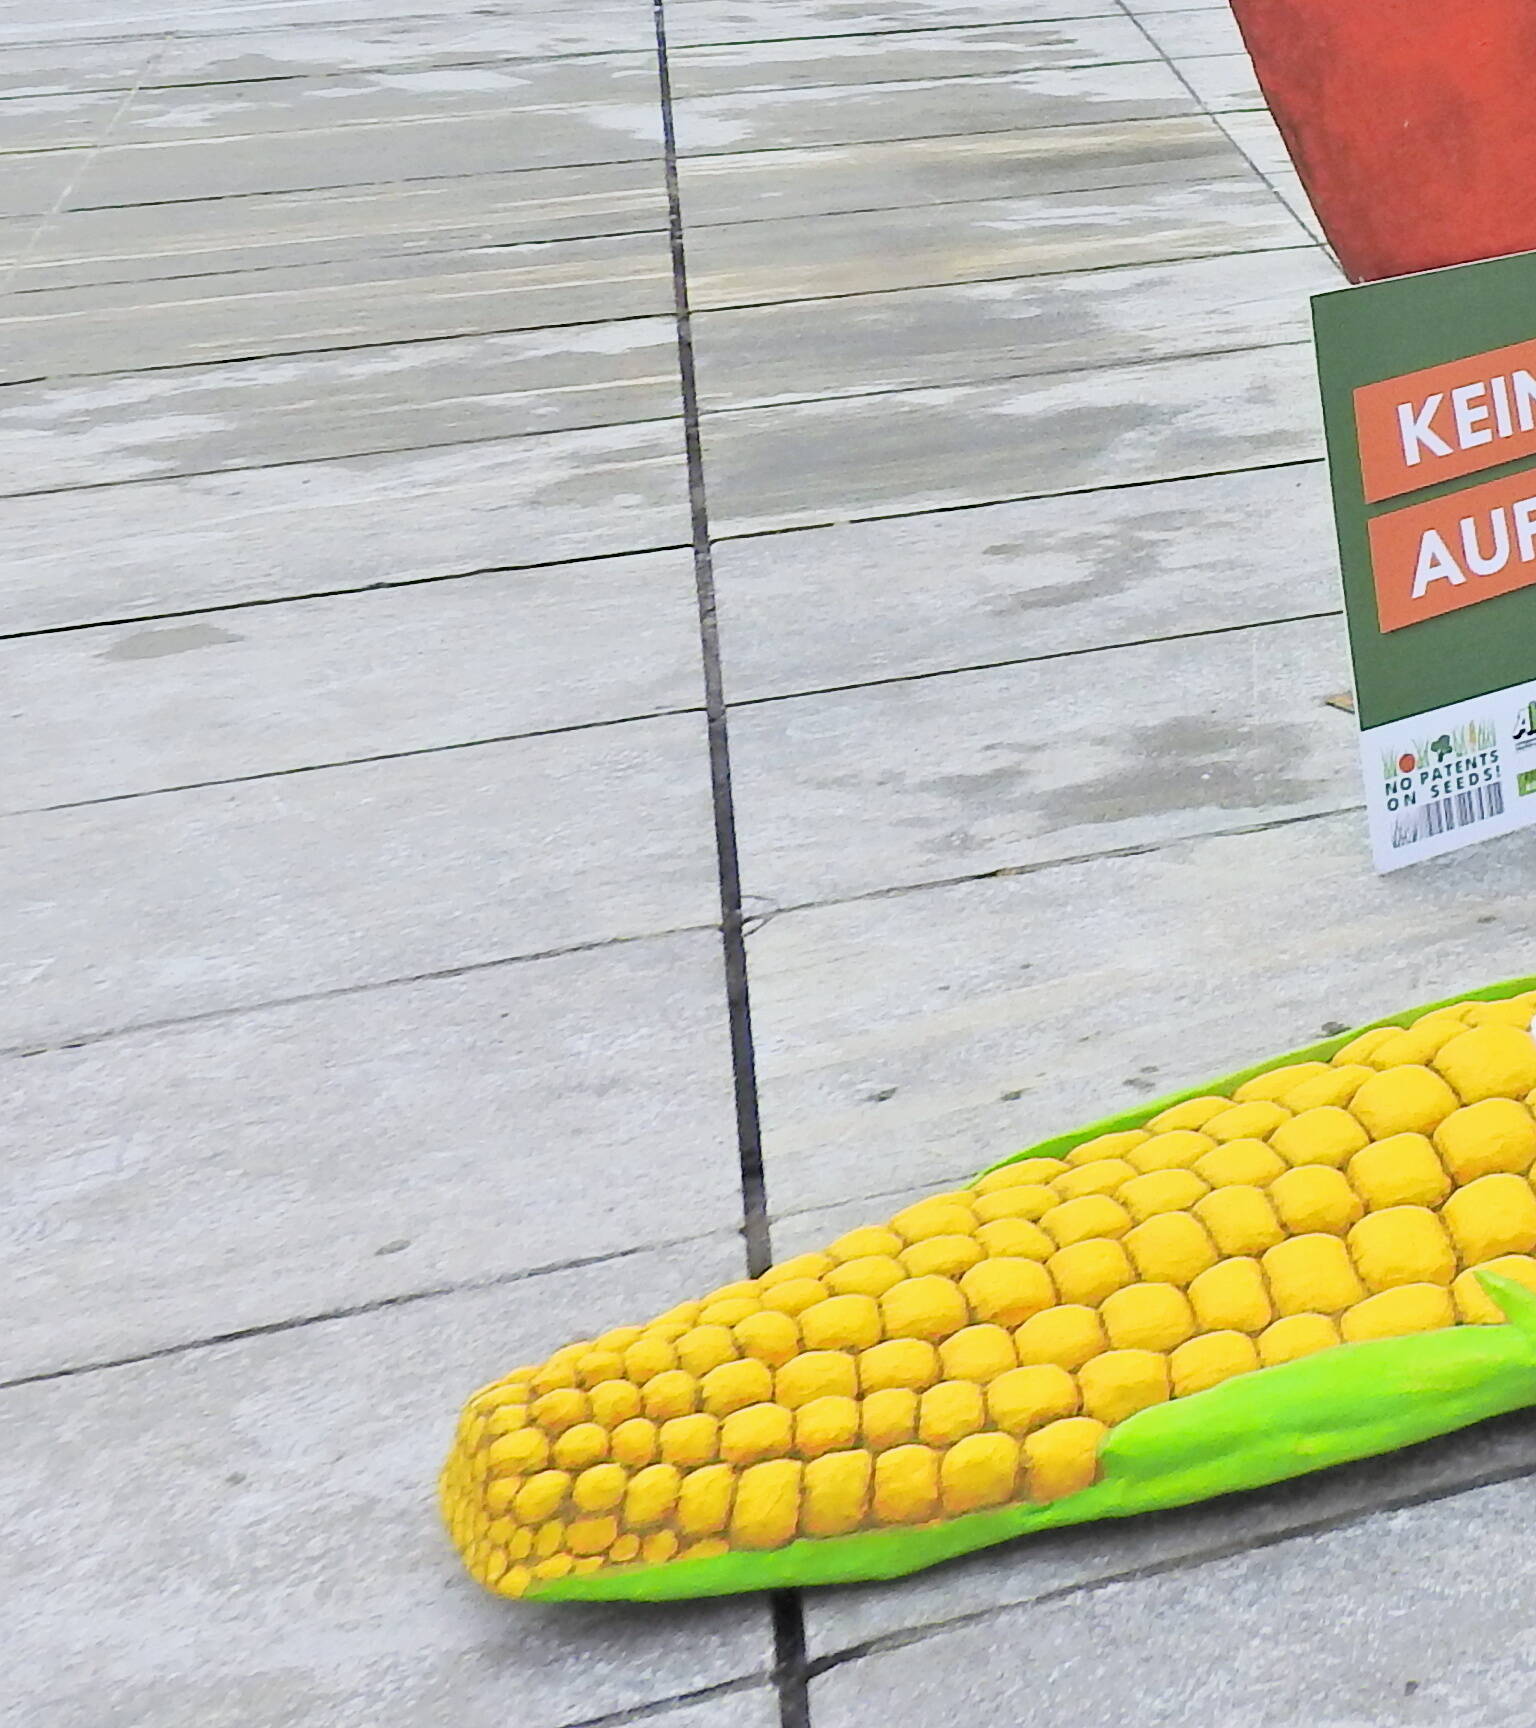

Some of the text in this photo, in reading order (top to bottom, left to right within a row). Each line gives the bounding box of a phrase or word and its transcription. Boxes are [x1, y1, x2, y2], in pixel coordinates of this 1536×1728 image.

[1385, 776, 1412, 797] NO
[1420, 749, 1500, 785] PATENTS
[1387, 792, 1417, 812] ON
[1430, 765, 1502, 798] SEEDS!
